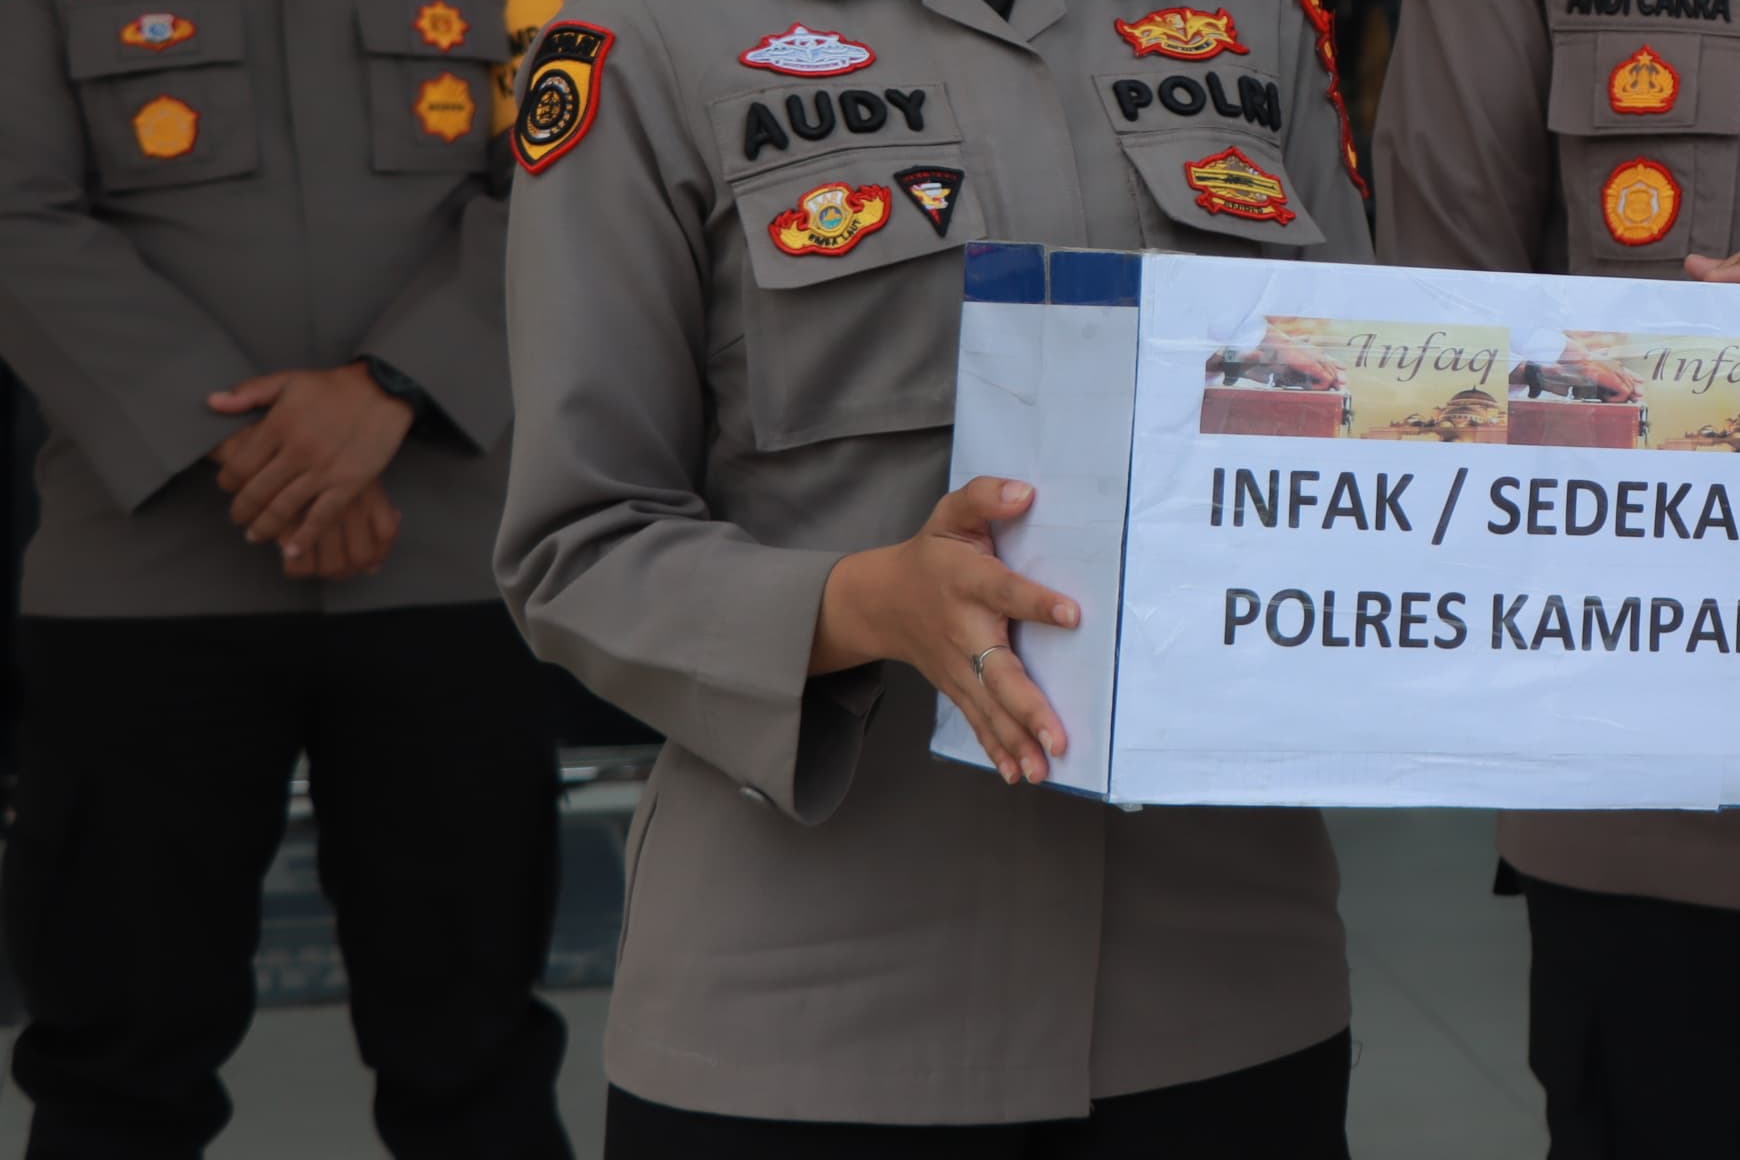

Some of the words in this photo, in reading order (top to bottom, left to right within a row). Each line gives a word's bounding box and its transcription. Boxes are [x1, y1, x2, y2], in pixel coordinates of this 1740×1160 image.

[743, 88, 928, 162] AUDY
[1111, 70, 1283, 133] POLRI
[1347, 331, 1499, 385] Infaq
[1211, 467, 1413, 533] INFAK
[1432, 467, 1469, 546] /
[1223, 588, 1467, 650] POLRES
